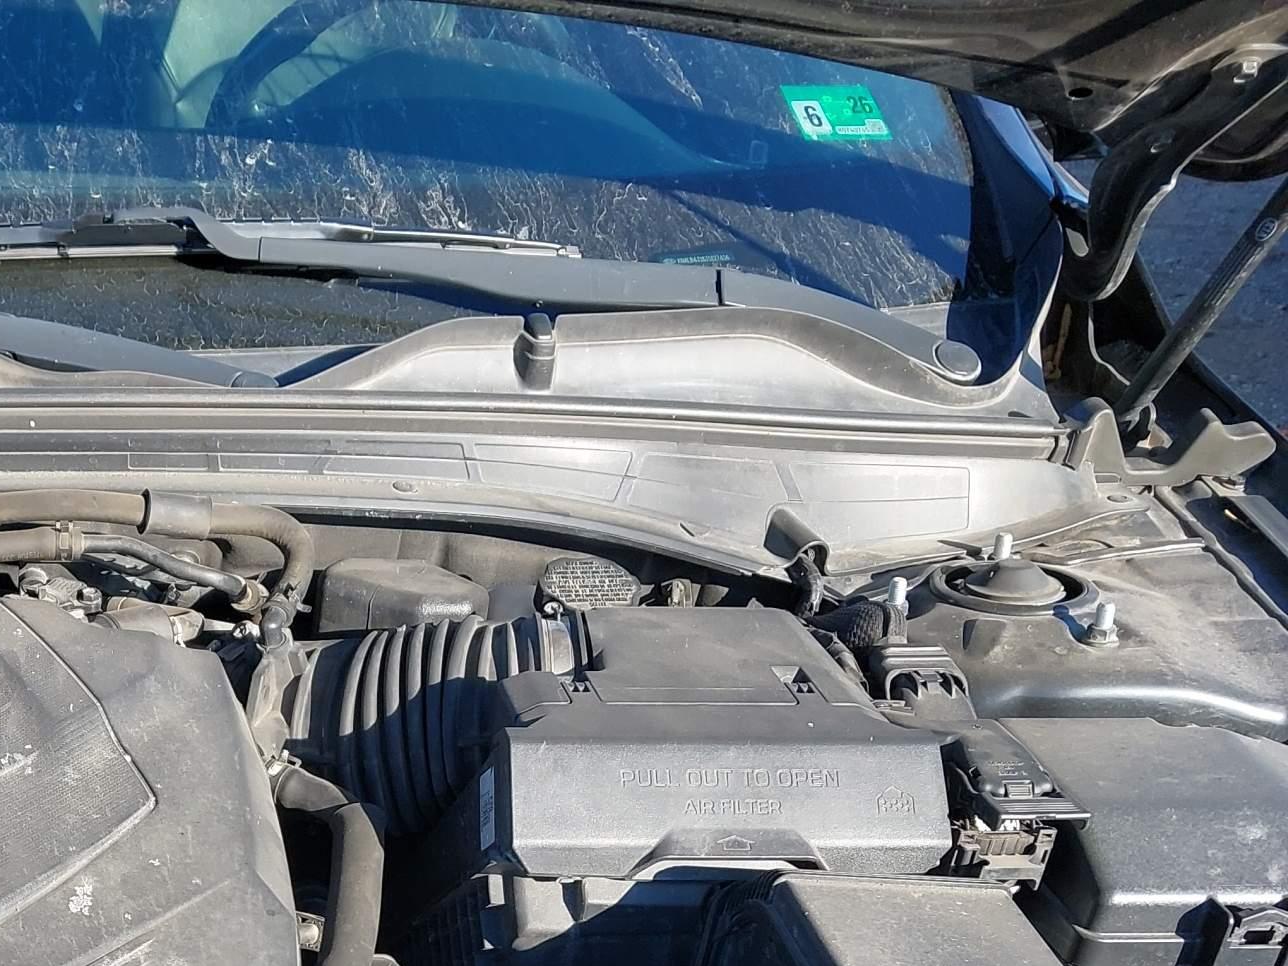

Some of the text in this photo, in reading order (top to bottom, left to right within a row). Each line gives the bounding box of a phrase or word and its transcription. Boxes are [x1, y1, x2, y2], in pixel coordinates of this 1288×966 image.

[846, 96, 874, 113] 26
[803, 105, 823, 127] 6
[620, 769, 840, 788] PULL OUT TO OPEN
[684, 799, 783, 815] AIR FILTER
